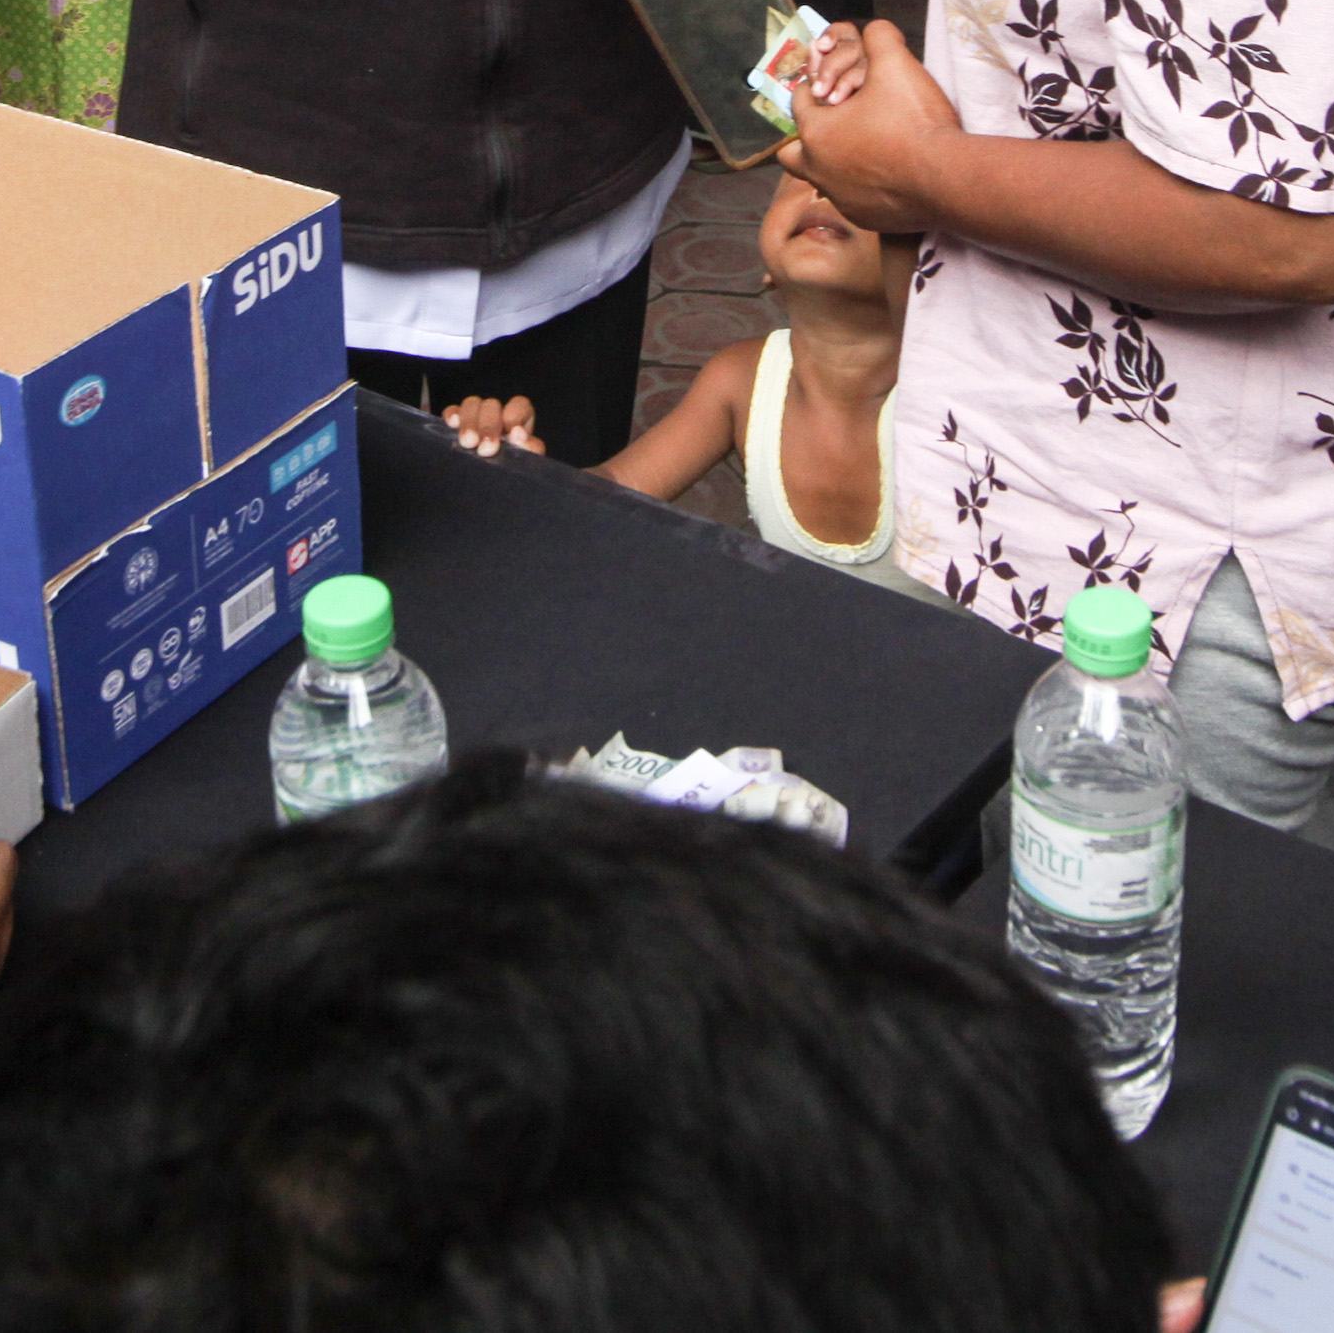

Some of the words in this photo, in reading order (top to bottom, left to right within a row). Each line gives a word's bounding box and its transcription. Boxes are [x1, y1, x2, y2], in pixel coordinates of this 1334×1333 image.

[232, 222, 322, 316] SiDU
[204, 517, 229, 548] A4
[235, 497, 265, 534] 70
[309, 517, 338, 549] APP
